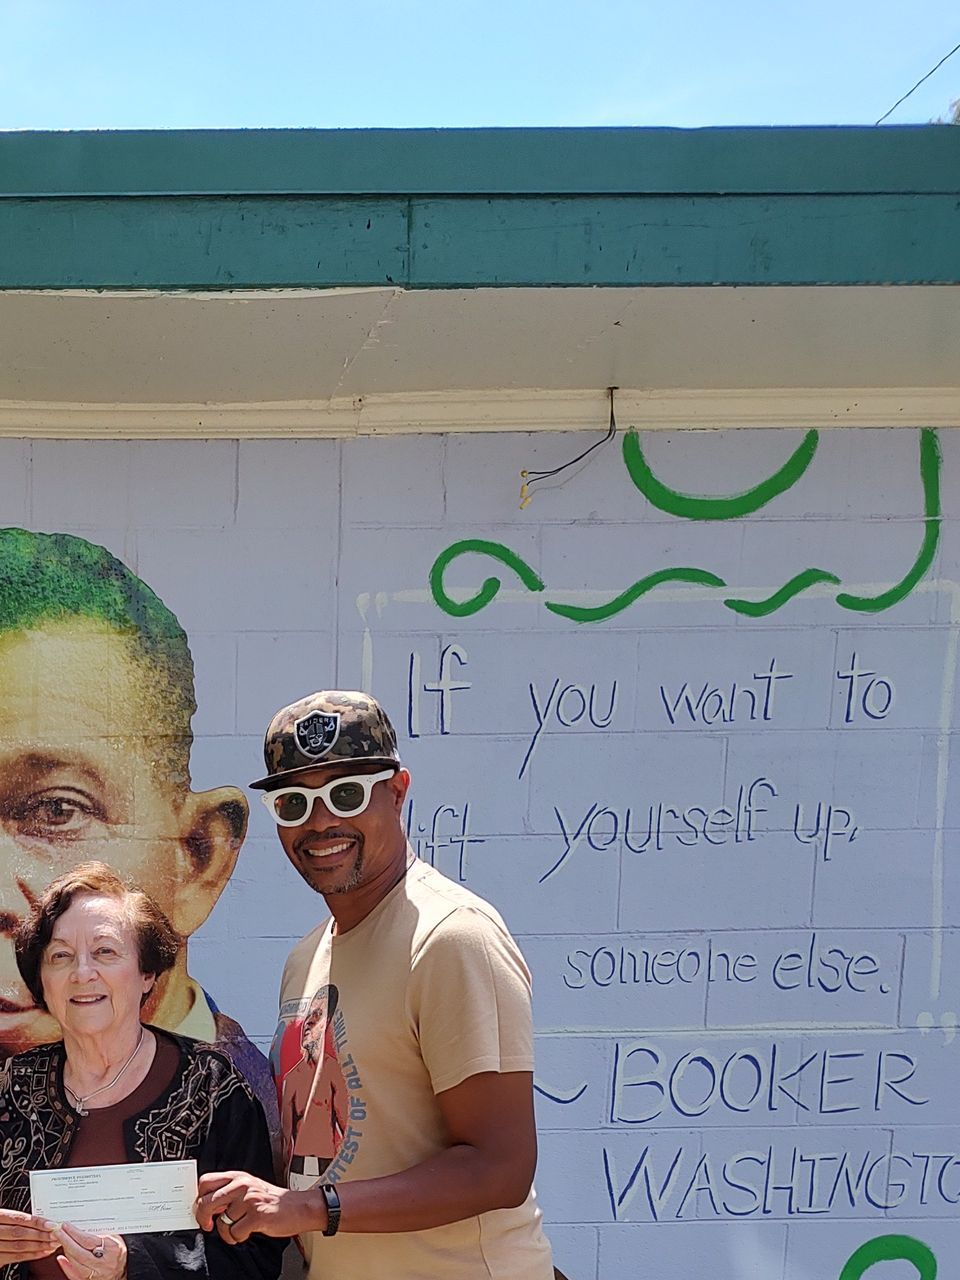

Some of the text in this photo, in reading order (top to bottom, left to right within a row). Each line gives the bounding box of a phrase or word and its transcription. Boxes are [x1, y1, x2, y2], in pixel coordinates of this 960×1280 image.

[407, 643, 894, 780] If you want to
[539, 777, 779, 883] yourself
[561, 932, 891, 993] someone else.
[342, 1053, 363, 1090] ALL
[610, 1042, 930, 1123] BOOKER
[349, 1095, 368, 1122] OF
[322, 1126, 363, 1184] ATEST
